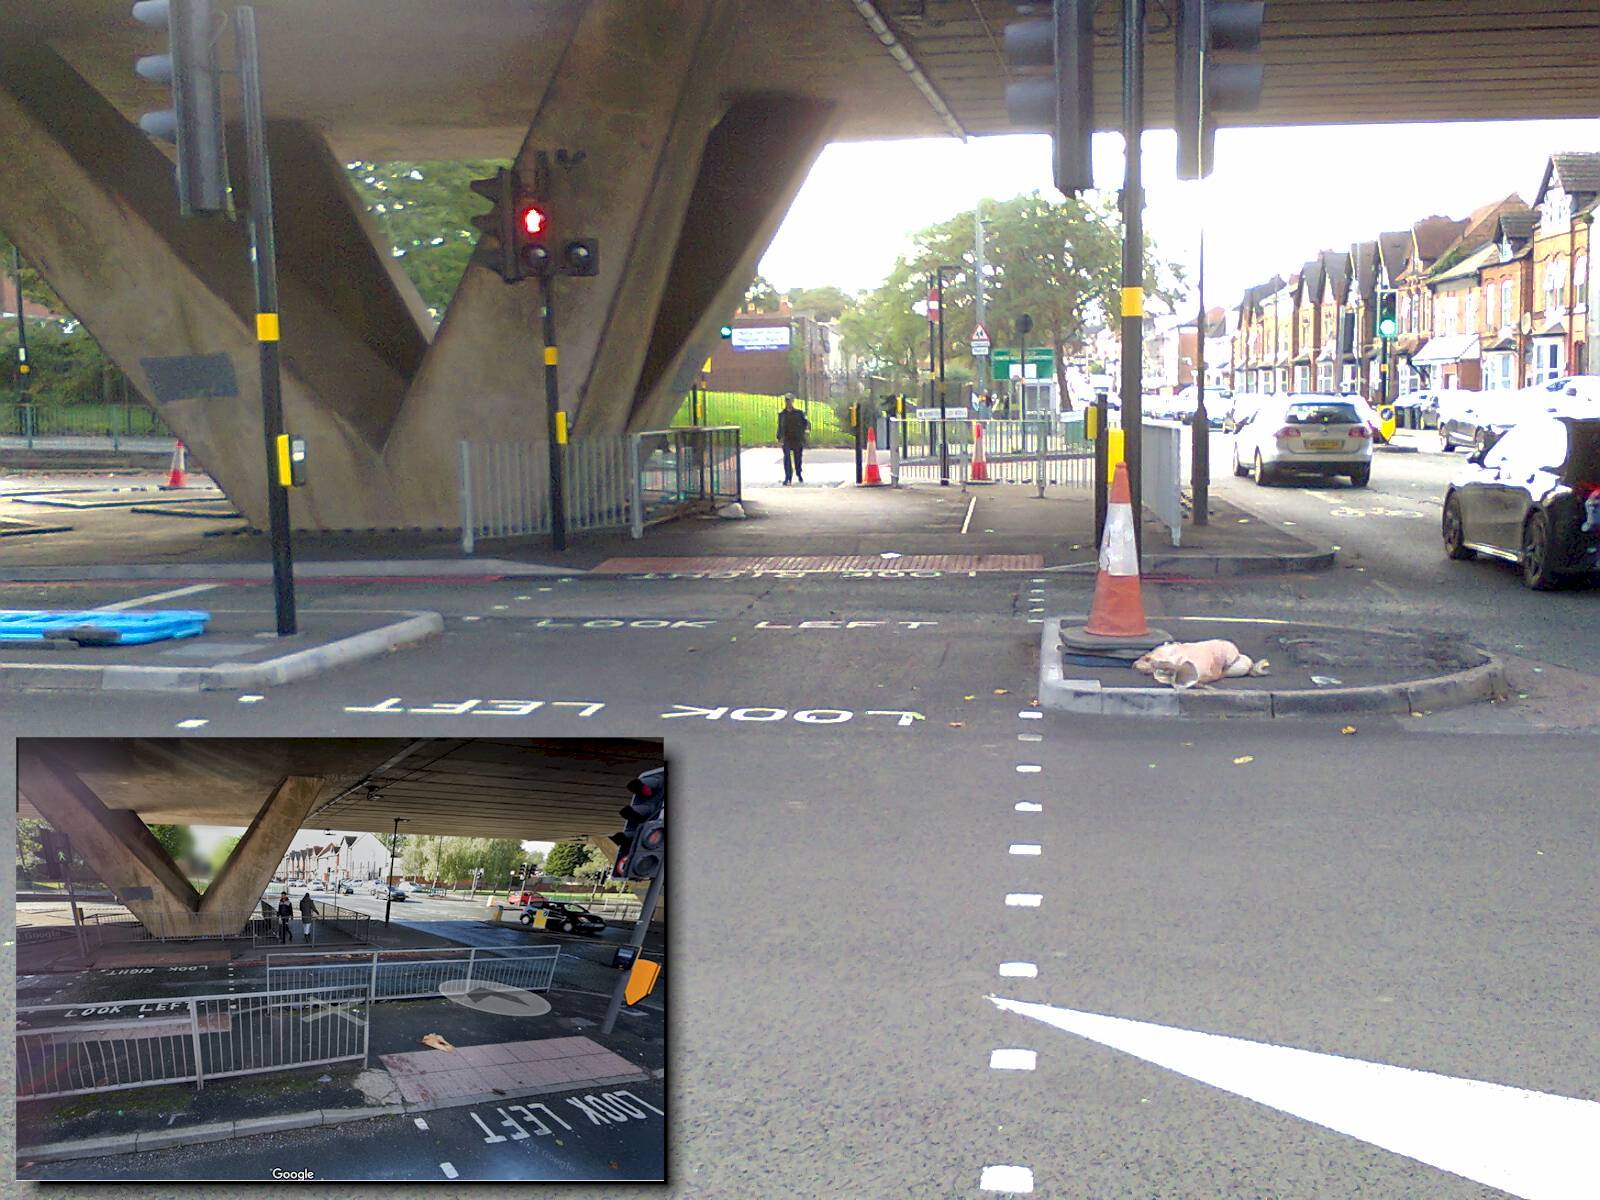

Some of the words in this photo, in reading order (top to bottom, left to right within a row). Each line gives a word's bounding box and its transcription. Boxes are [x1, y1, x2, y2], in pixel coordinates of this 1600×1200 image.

[536, 619, 717, 628] LOOK
[754, 620, 939, 629] LEFT
[344, 697, 606, 717] LEFT
[661, 704, 915, 726] LOOK
[168, 965, 208, 973] LOOK
[64, 1005, 124, 1018] LOOK
[139, 1001, 192, 1013] LEFT
[566, 1090, 664, 1126] LOOK
[470, 1102, 572, 1144] LEFT
